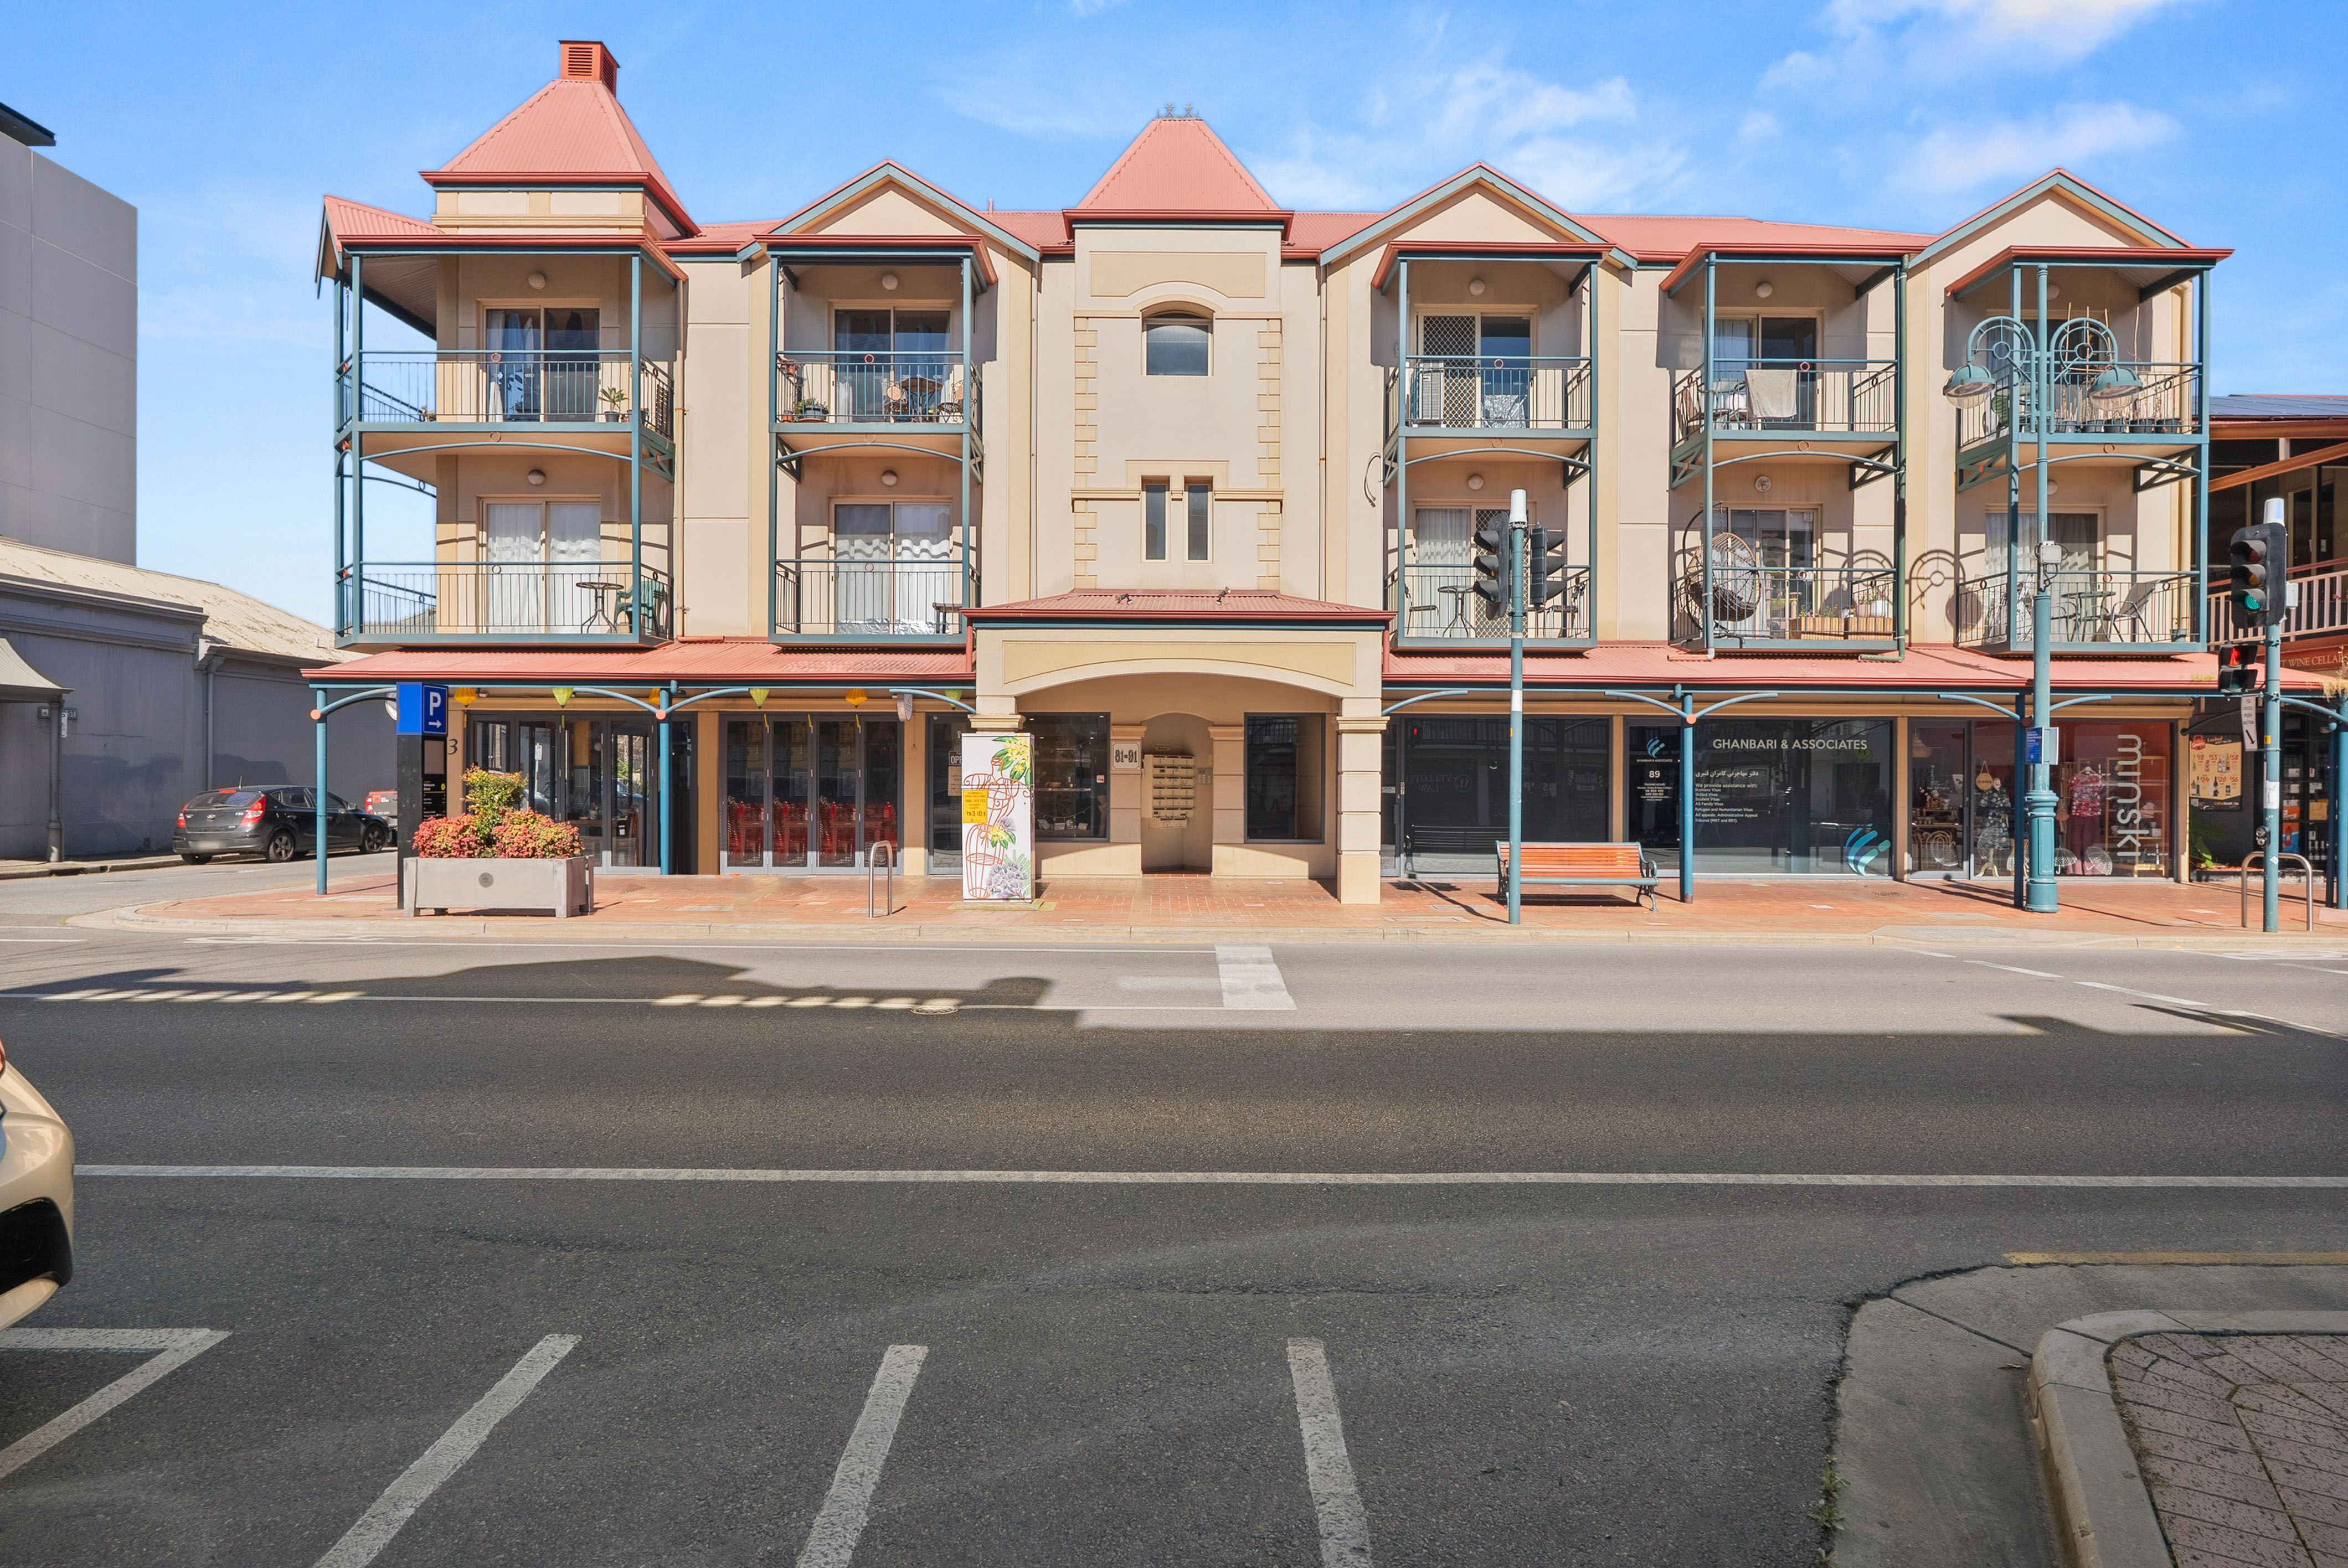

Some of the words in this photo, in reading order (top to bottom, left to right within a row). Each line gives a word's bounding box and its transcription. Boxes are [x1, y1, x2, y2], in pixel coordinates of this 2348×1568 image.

[2288, 657, 2310, 667] WINE
[430, 692, 441, 716] P
[1713, 739, 1777, 749] GHANBARI
[1781, 740, 1788, 749] &
[1792, 739, 1867, 750] ASSOCIATES
[950, 755, 961, 764] OPE
[1115, 749, 1137, 763] 81-91
[1401, 782, 1404, 794] 87
[2117, 734, 2149, 857] minski
